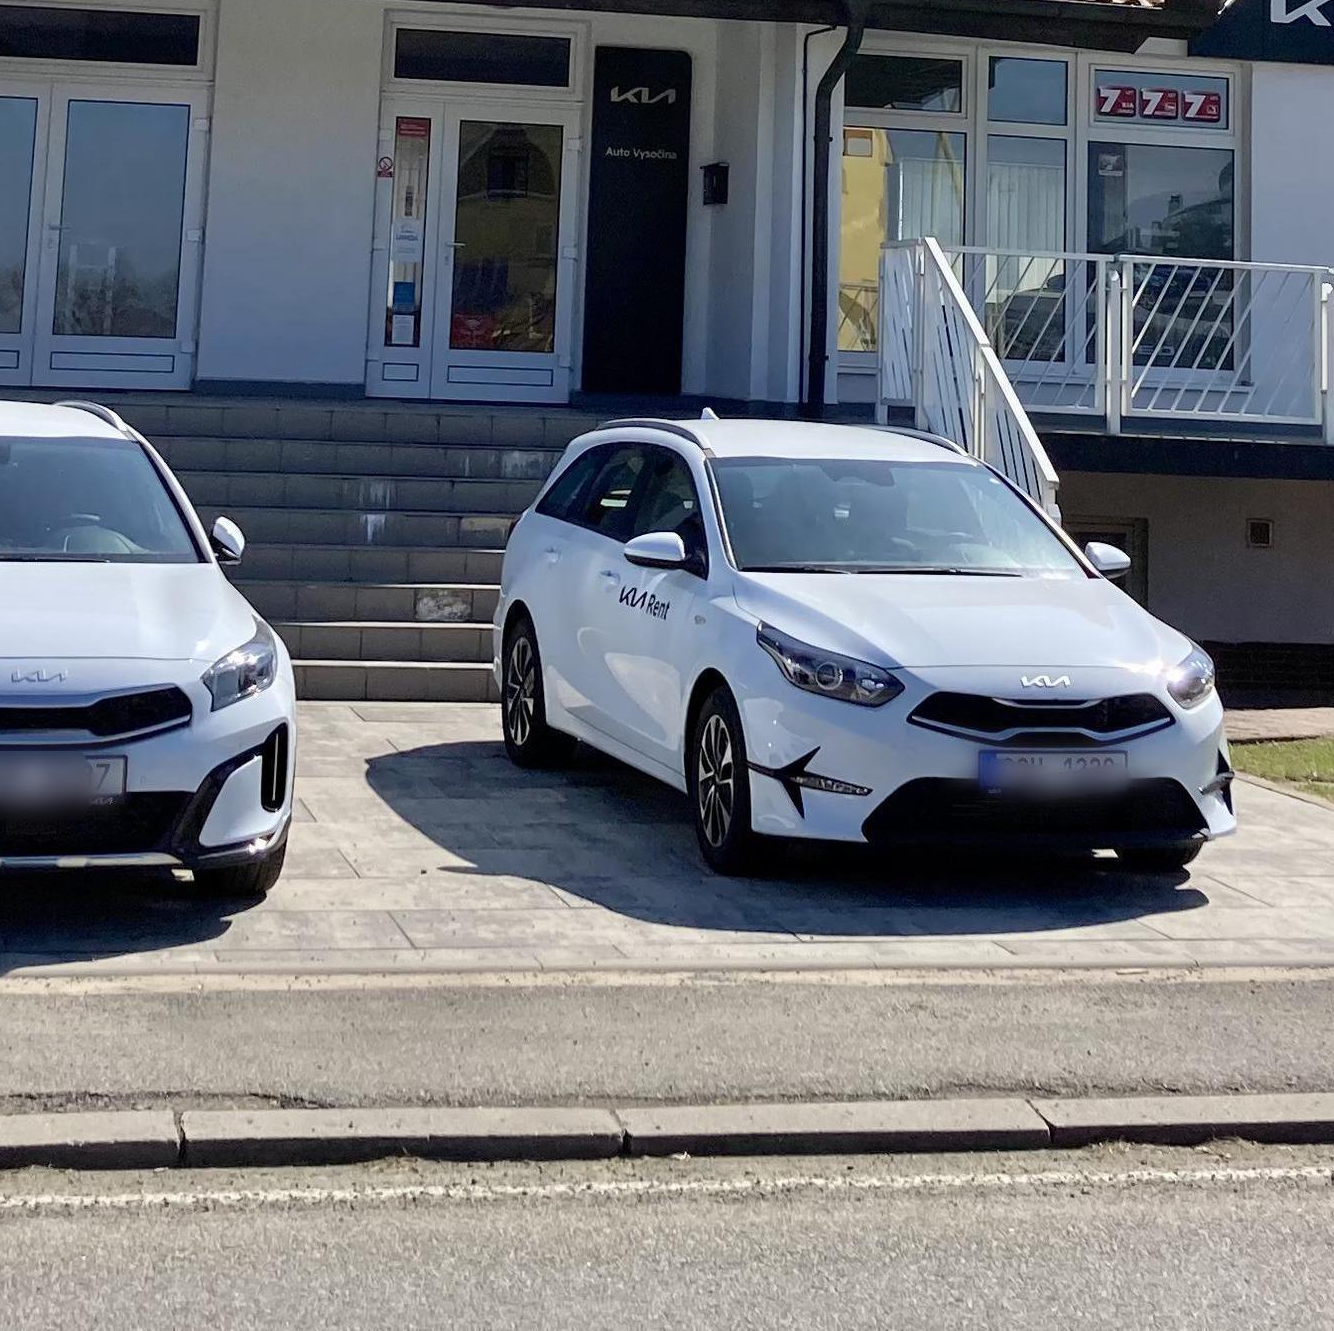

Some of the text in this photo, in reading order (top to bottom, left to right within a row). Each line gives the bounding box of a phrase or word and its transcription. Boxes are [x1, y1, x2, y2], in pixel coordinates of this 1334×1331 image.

[605, 146, 678, 160] Auto Vysočina
[646, 593, 670, 621] Rent
